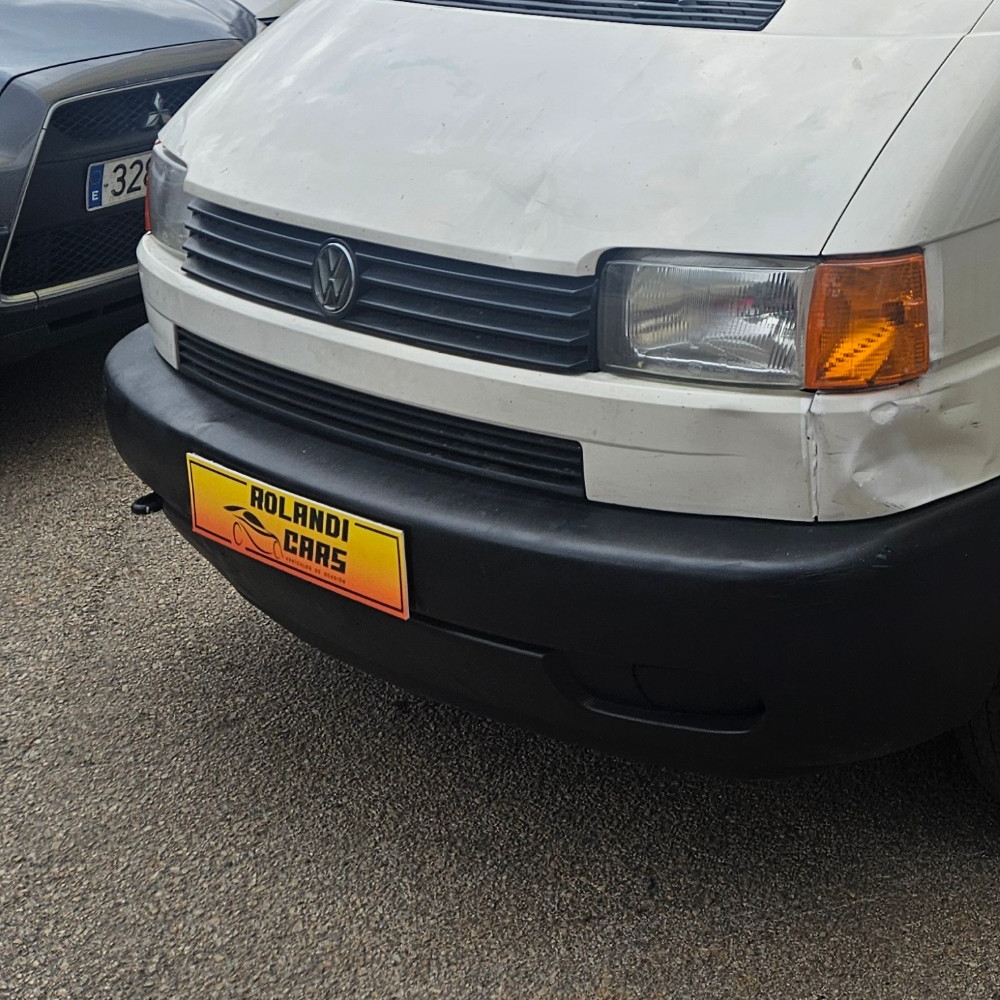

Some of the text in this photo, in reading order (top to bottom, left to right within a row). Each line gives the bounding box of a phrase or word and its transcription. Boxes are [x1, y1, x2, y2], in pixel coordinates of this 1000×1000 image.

[91, 190, 99, 201] E
[250, 485, 350, 543] ROLANDI
[283, 528, 348, 575] CARS
